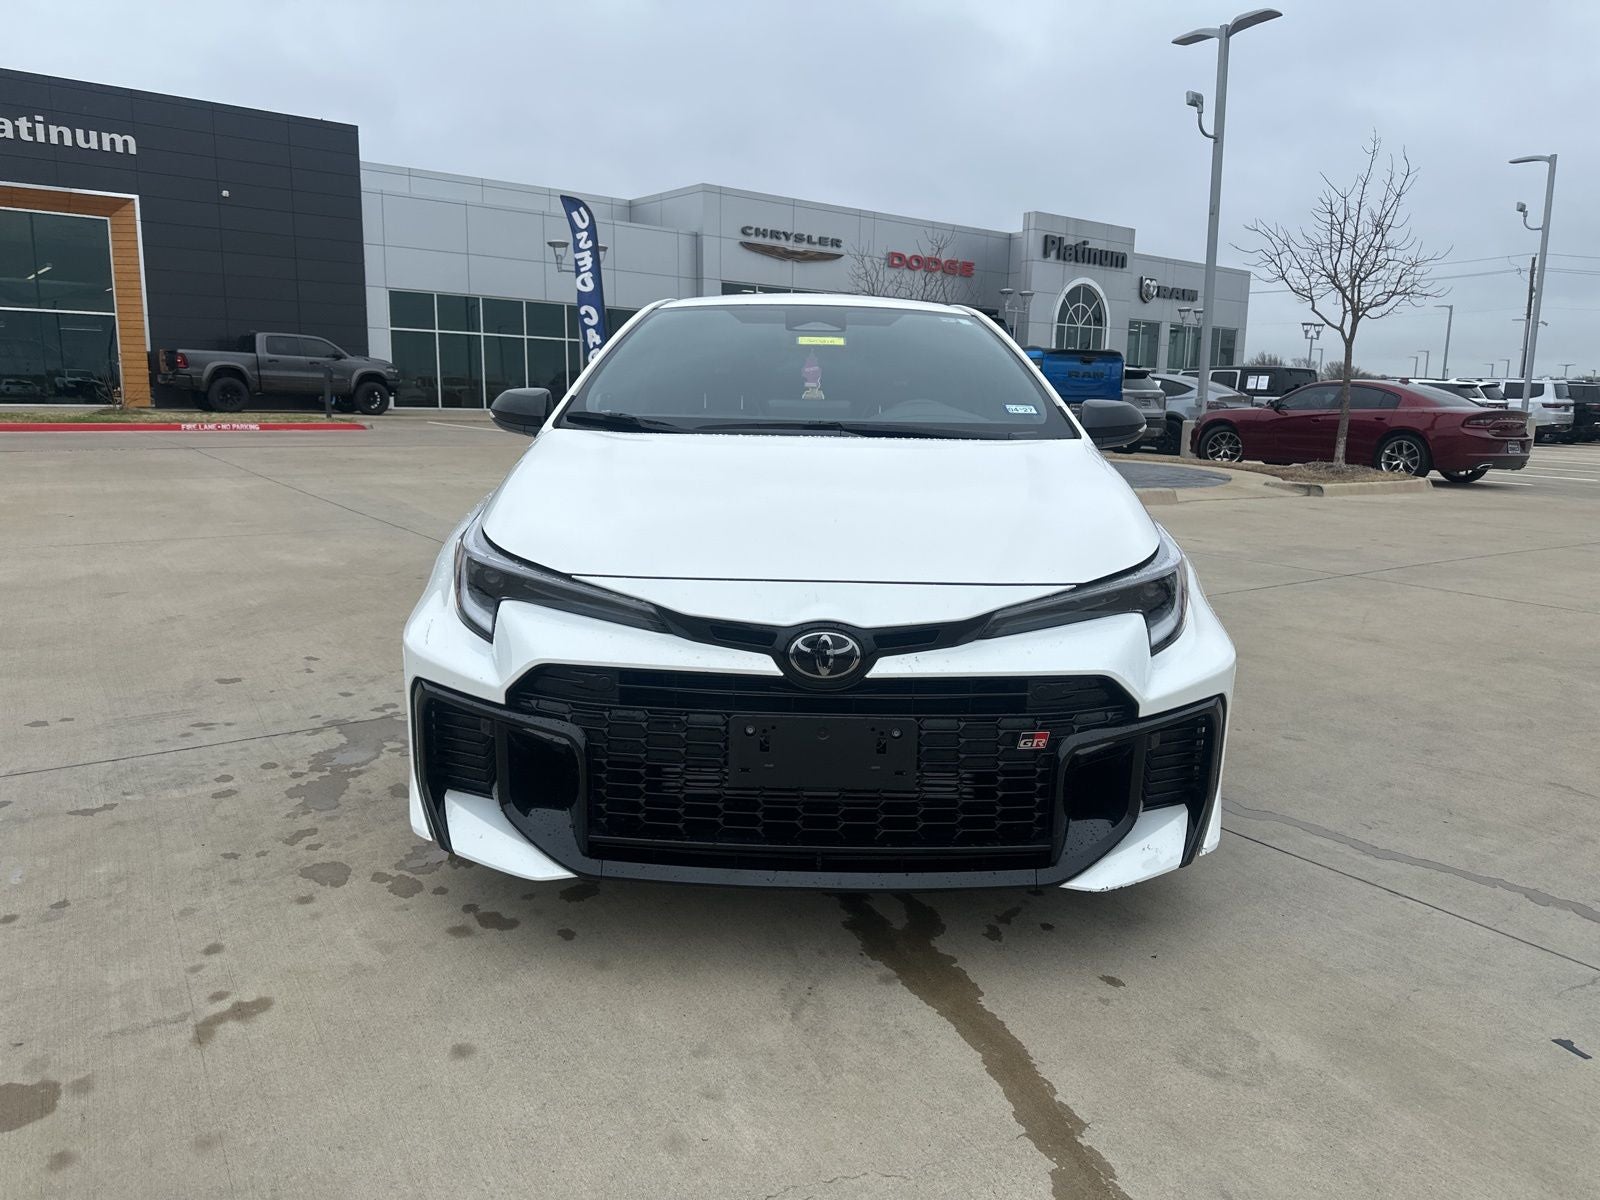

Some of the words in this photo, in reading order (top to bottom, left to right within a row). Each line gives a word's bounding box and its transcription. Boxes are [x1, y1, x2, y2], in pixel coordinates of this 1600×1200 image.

[0, 115, 137, 155] atinum
[740, 225, 843, 248] CHRYSLER
[1043, 233, 1128, 269] Platinum
[888, 251, 976, 278] DODGE
[1156, 285, 1199, 302] RAM
[1068, 369, 1105, 379] RAM
